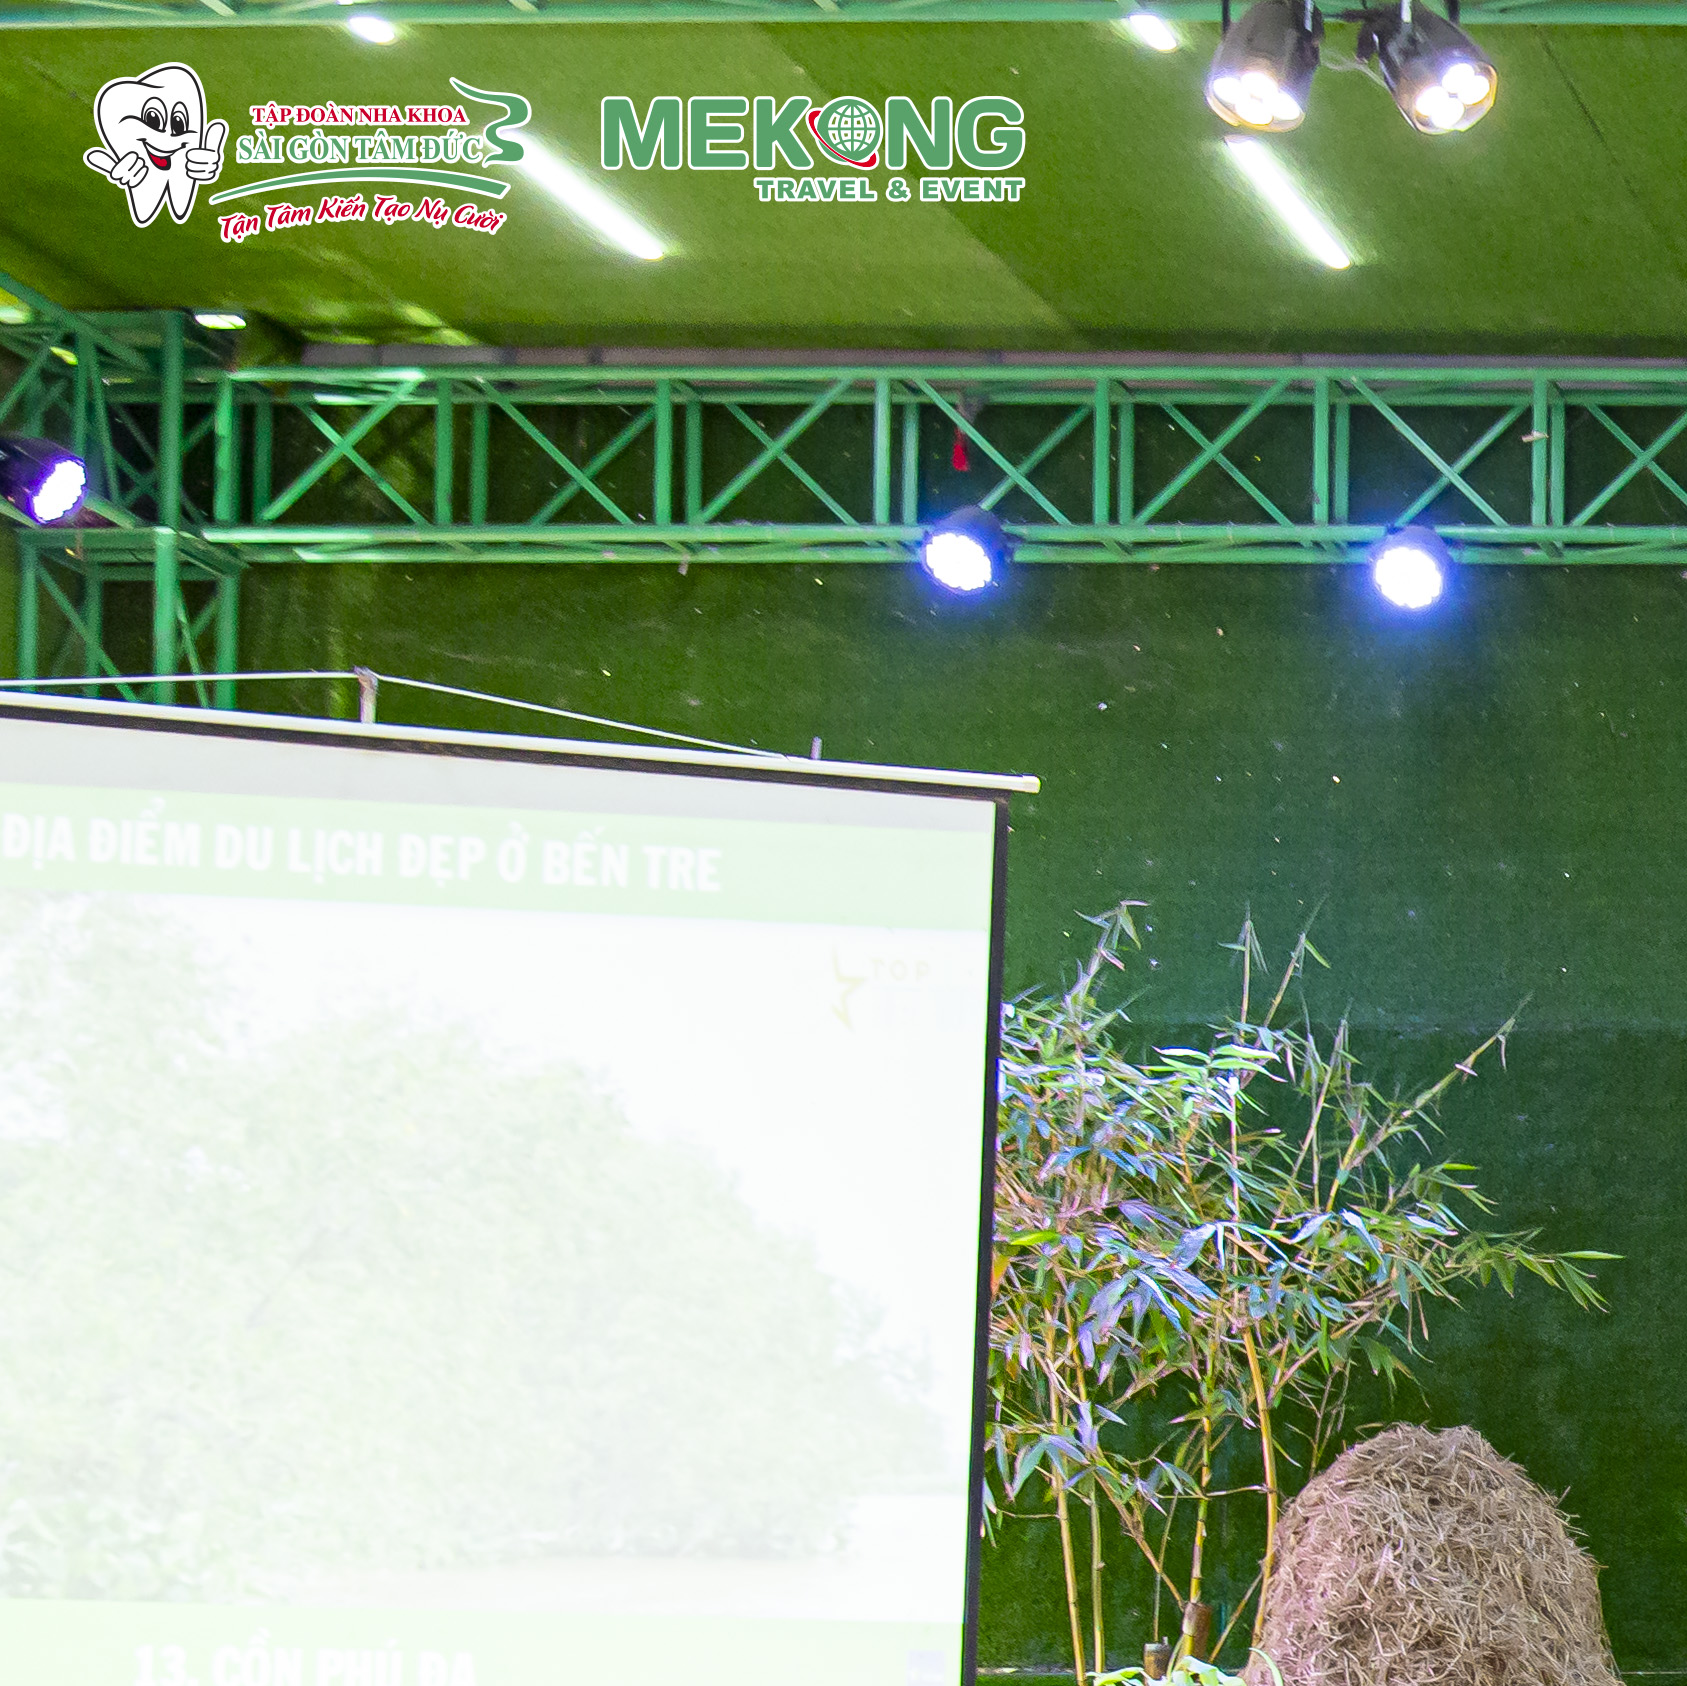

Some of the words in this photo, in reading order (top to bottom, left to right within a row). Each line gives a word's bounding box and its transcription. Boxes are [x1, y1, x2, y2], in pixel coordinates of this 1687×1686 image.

[1, 813, 76, 871] ĐỊA
[88, 800, 203, 868] ĐIỂM
[214, 824, 275, 871] DU
[286, 827, 384, 885] LỊCH
[496, 820, 532, 884] Ở
[542, 825, 629, 888] BẾN
[643, 844, 722, 892] TRE
